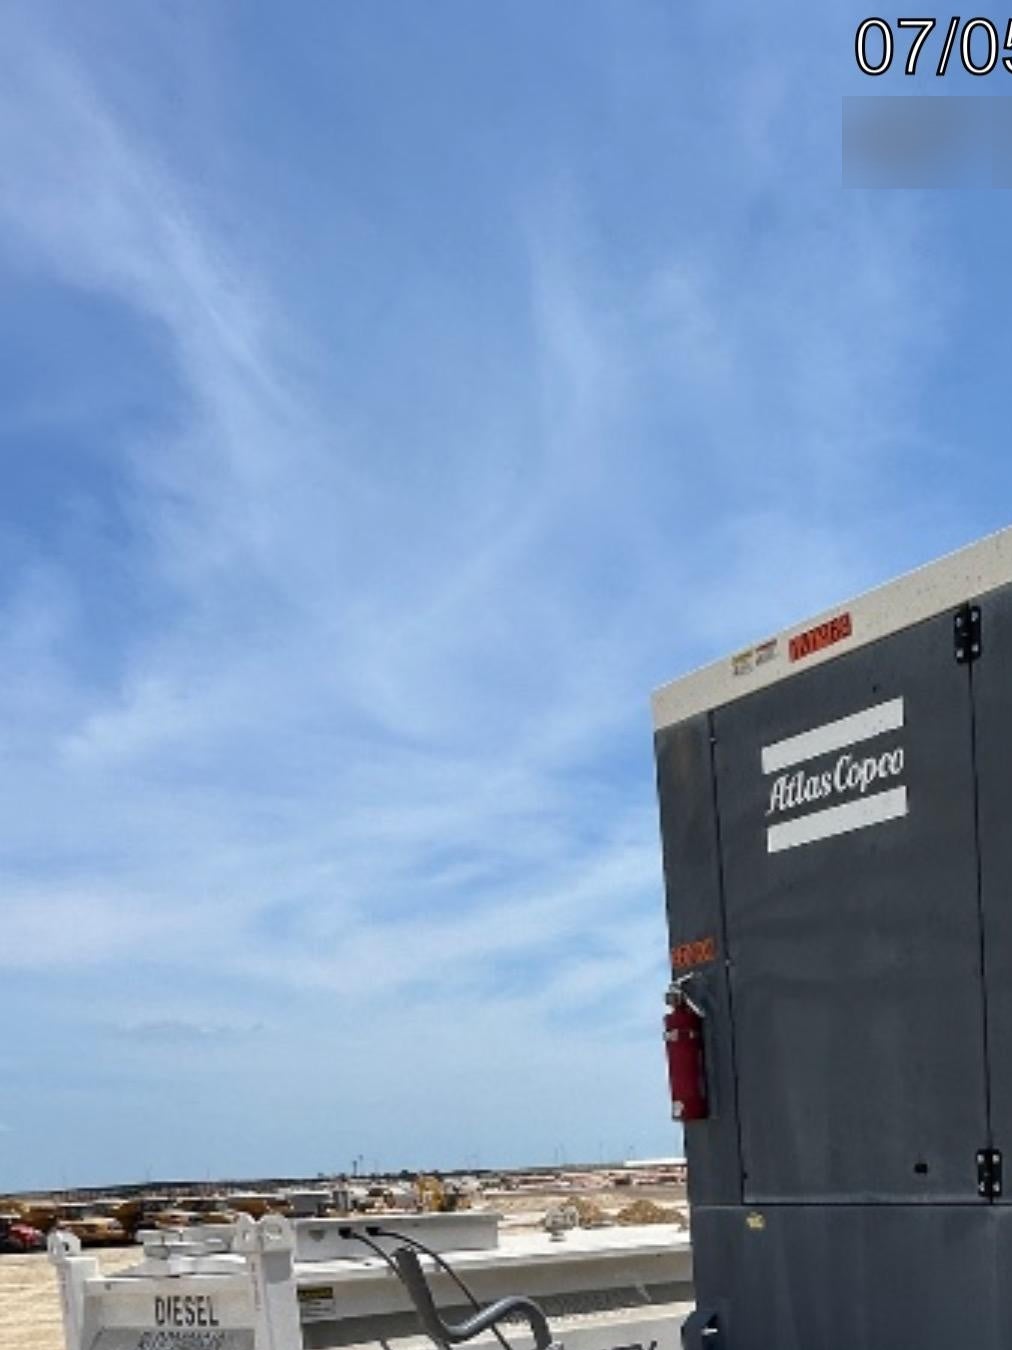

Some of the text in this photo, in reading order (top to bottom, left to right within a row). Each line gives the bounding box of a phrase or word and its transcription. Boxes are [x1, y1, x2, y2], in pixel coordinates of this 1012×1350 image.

[765, 747, 904, 816] Atlas Copco
[154, 1295, 219, 1327] DIESEL
